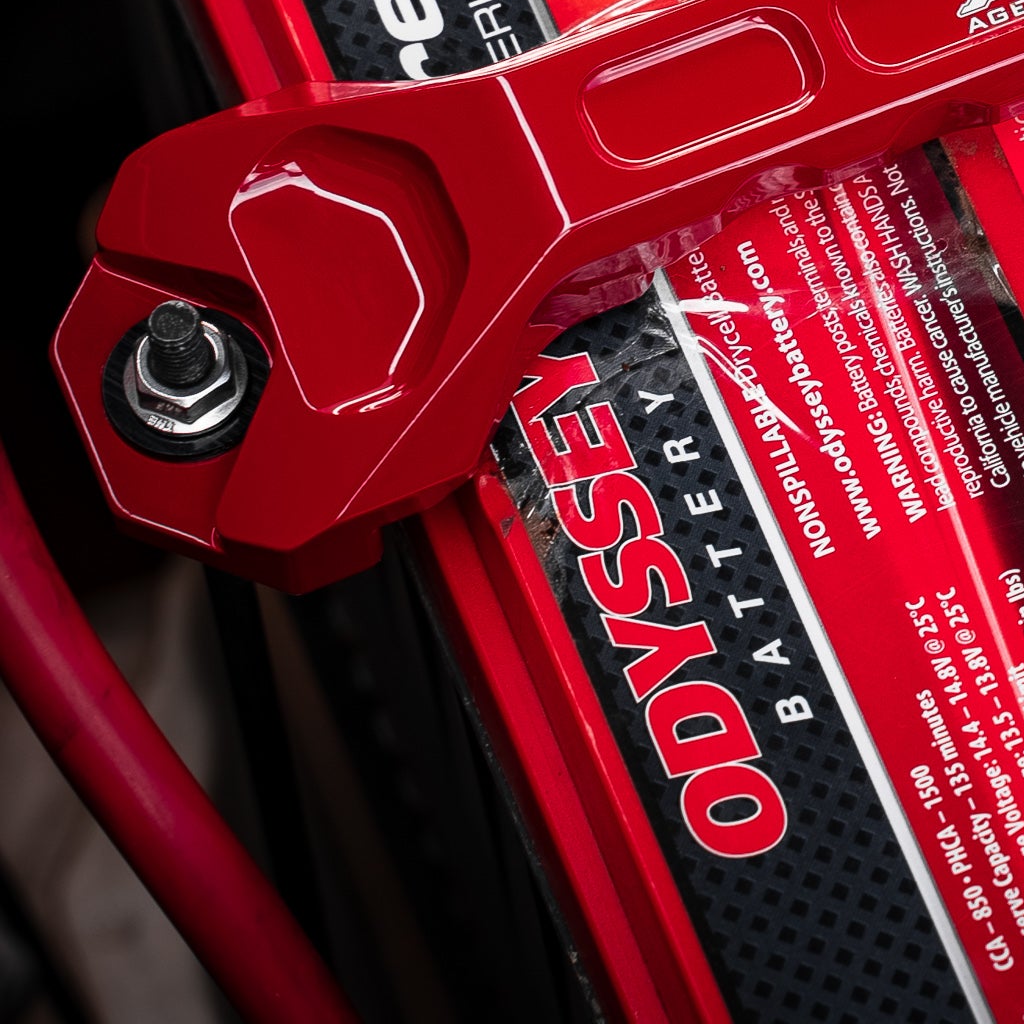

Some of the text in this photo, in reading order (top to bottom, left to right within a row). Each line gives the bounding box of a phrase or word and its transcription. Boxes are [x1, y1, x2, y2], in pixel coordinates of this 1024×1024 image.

[768, 204, 800, 237] and
[802, 197, 826, 227] the
[815, 224, 835, 245] to
[857, 184, 900, 246] HANDS
[884, 242, 923, 296] WASH
[893, 193, 953, 291] instructions.
[782, 232, 835, 312] terminals,
[822, 243, 861, 301] known
[820, 305, 857, 355] posts,
[846, 298, 896, 378] chemicals
[913, 293, 948, 350] cancer.
[934, 284, 1007, 405] manufacturer's
[733, 237, 884, 540] www.odysseybattery.com
[839, 353, 881, 413] Battery
[900, 350, 939, 400] harm.
[937, 348, 969, 395] cause
[878, 371, 945, 477] compounds,
[957, 394, 978, 415] to
[738, 381, 837, 559] NONSPILLABLE
[864, 410, 928, 523] WARNING:
[922, 395, 989, 501] reproductive
[964, 413, 1012, 490] California
[923, 472, 957, 512] lead
[638, 389, 814, 724] BATTERY
[513, 352, 787, 857] ODYSSEY
[904, 595, 939, 638] 25°C
[935, 586, 970, 628] 25°C
[923, 636, 946, 655] @
[954, 626, 977, 646] @
[930, 654, 968, 706] 14.8V
[961, 644, 1000, 696] 13.8V
[912, 688, 959, 763] minutes
[961, 719, 993, 761] 14.4
[991, 710, 1024, 751] 13.5
[943, 761, 974, 797] 135
[909, 763, 1015, 972] CCA 850 PHCA 1500
[966, 810, 1017, 888] Capacity
